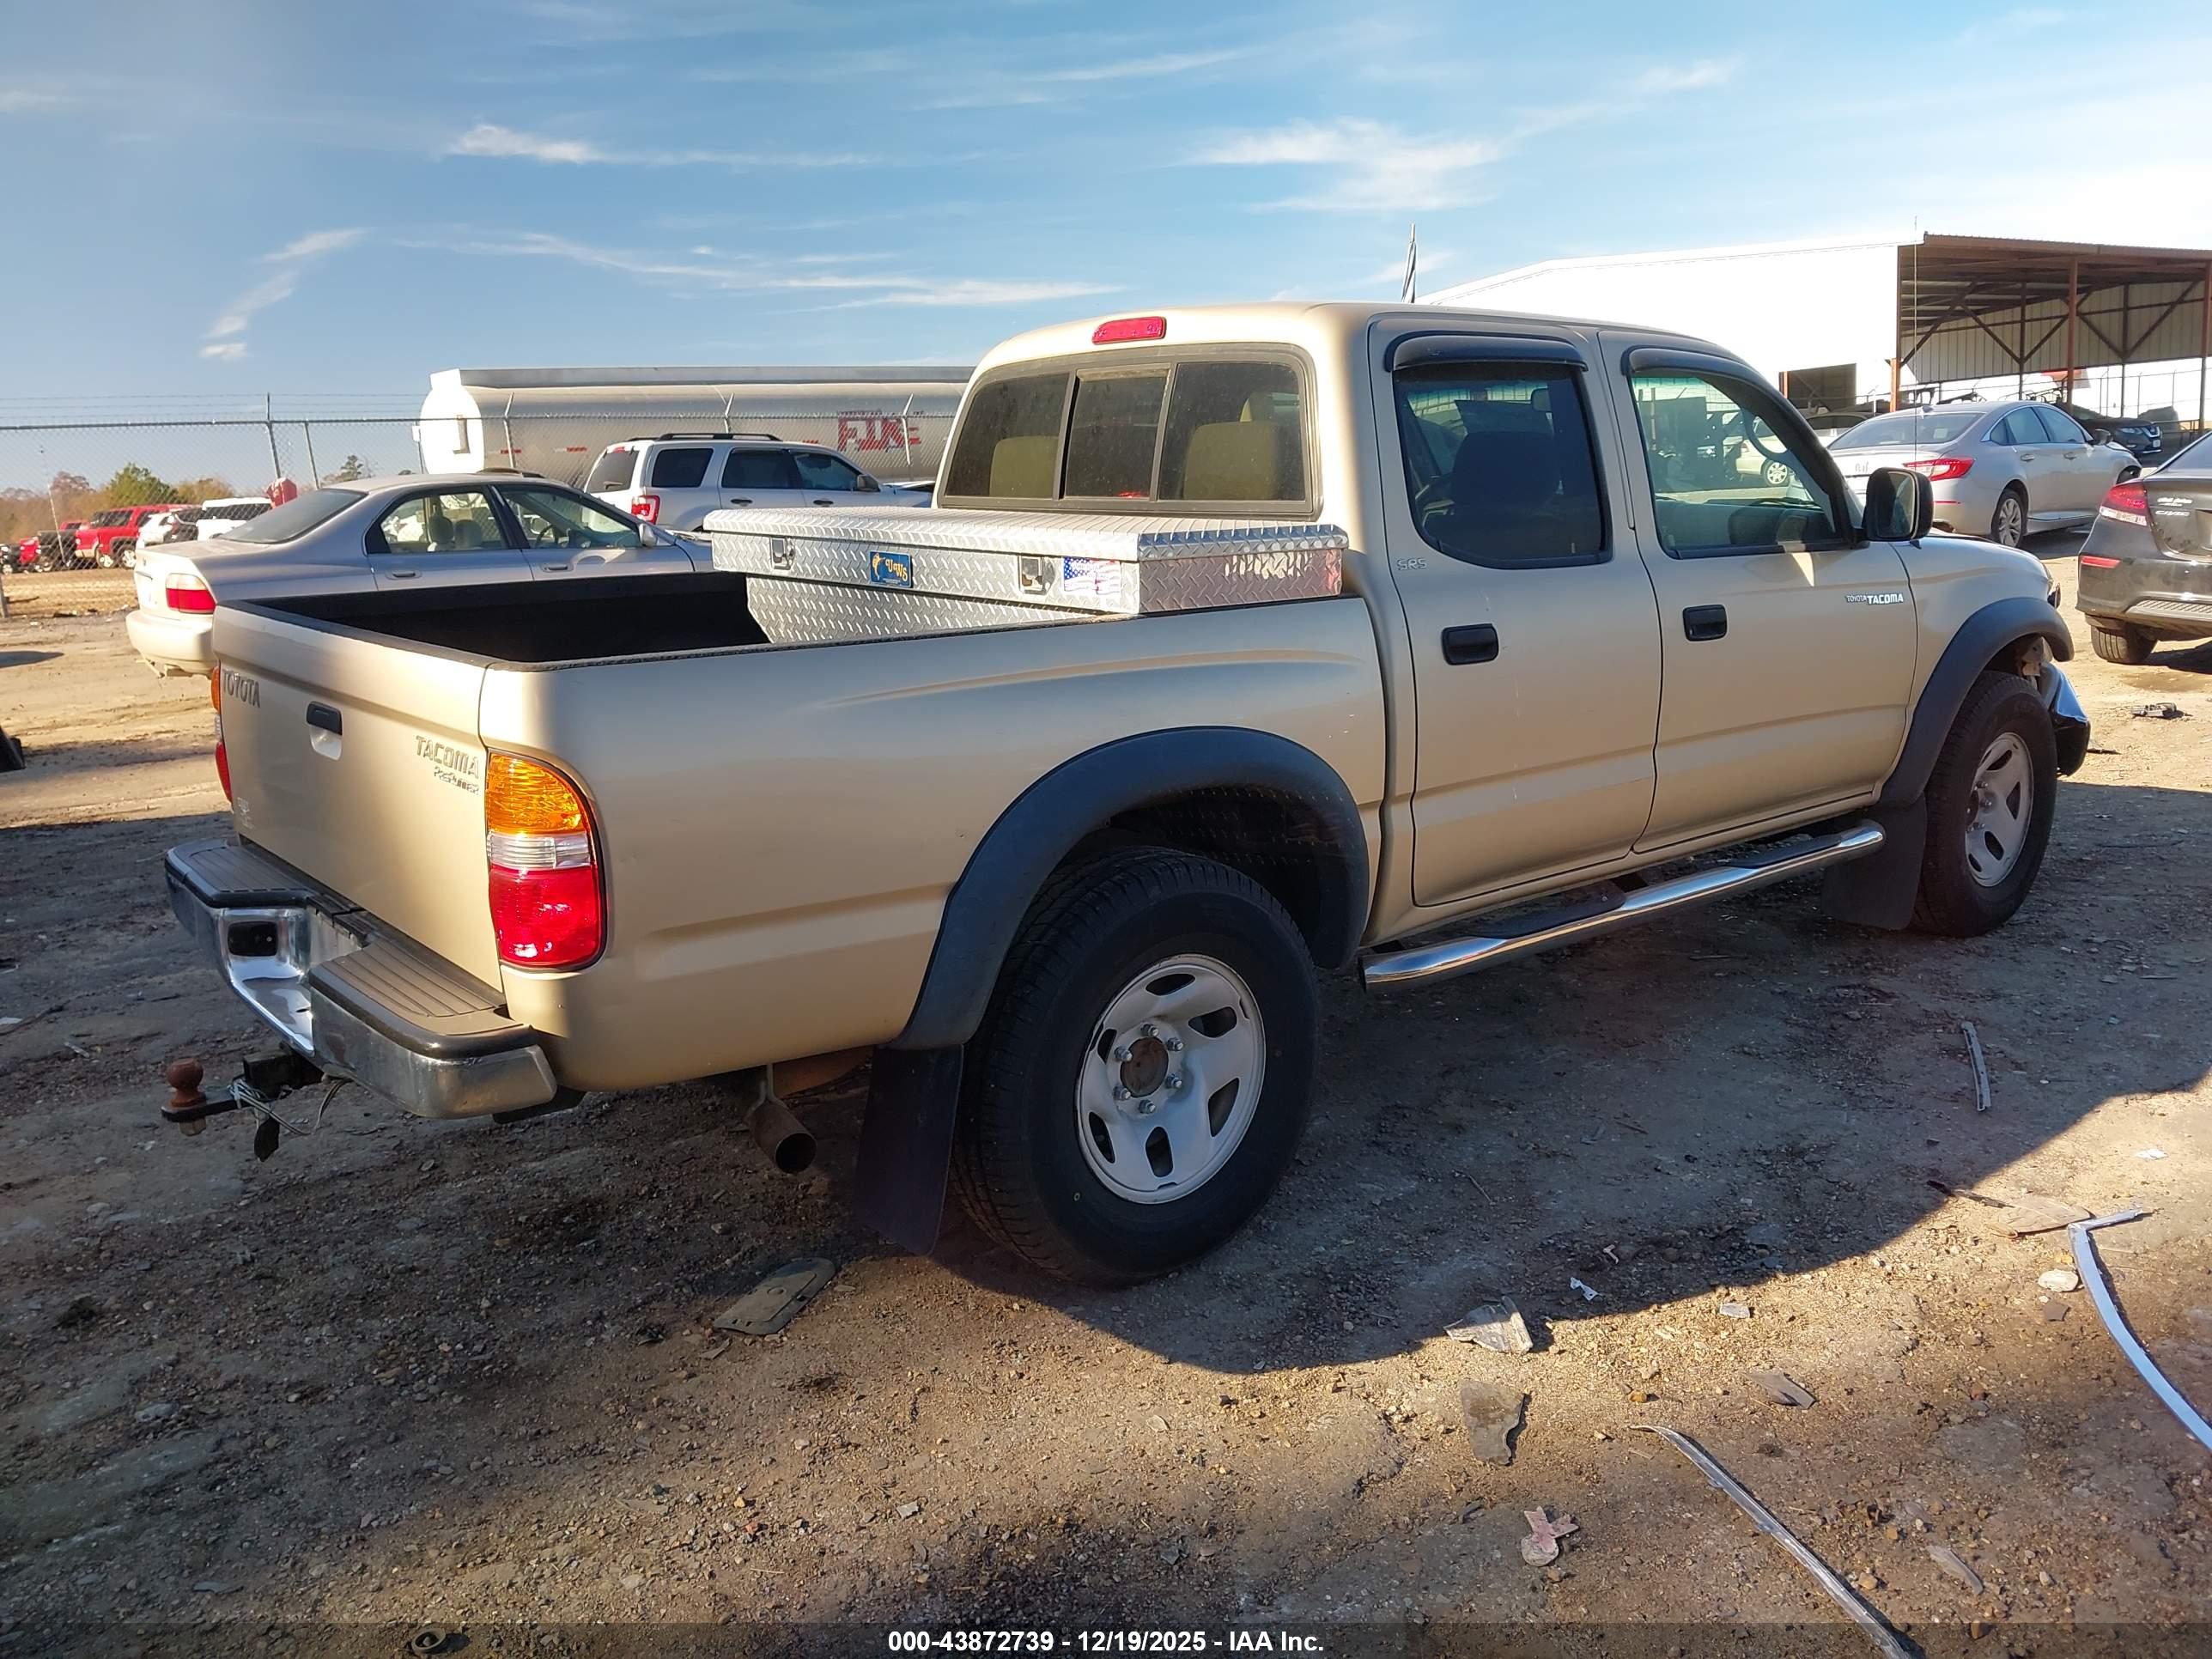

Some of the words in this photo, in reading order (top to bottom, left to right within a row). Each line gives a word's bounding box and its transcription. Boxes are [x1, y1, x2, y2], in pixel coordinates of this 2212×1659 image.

[1396, 557, 1427, 571] SRS
[1845, 594, 1867, 603] TOYOTA
[1867, 592, 1904, 605] TACOMA
[222, 668, 261, 708] TOYOTA
[416, 735, 479, 780] TACOMA
